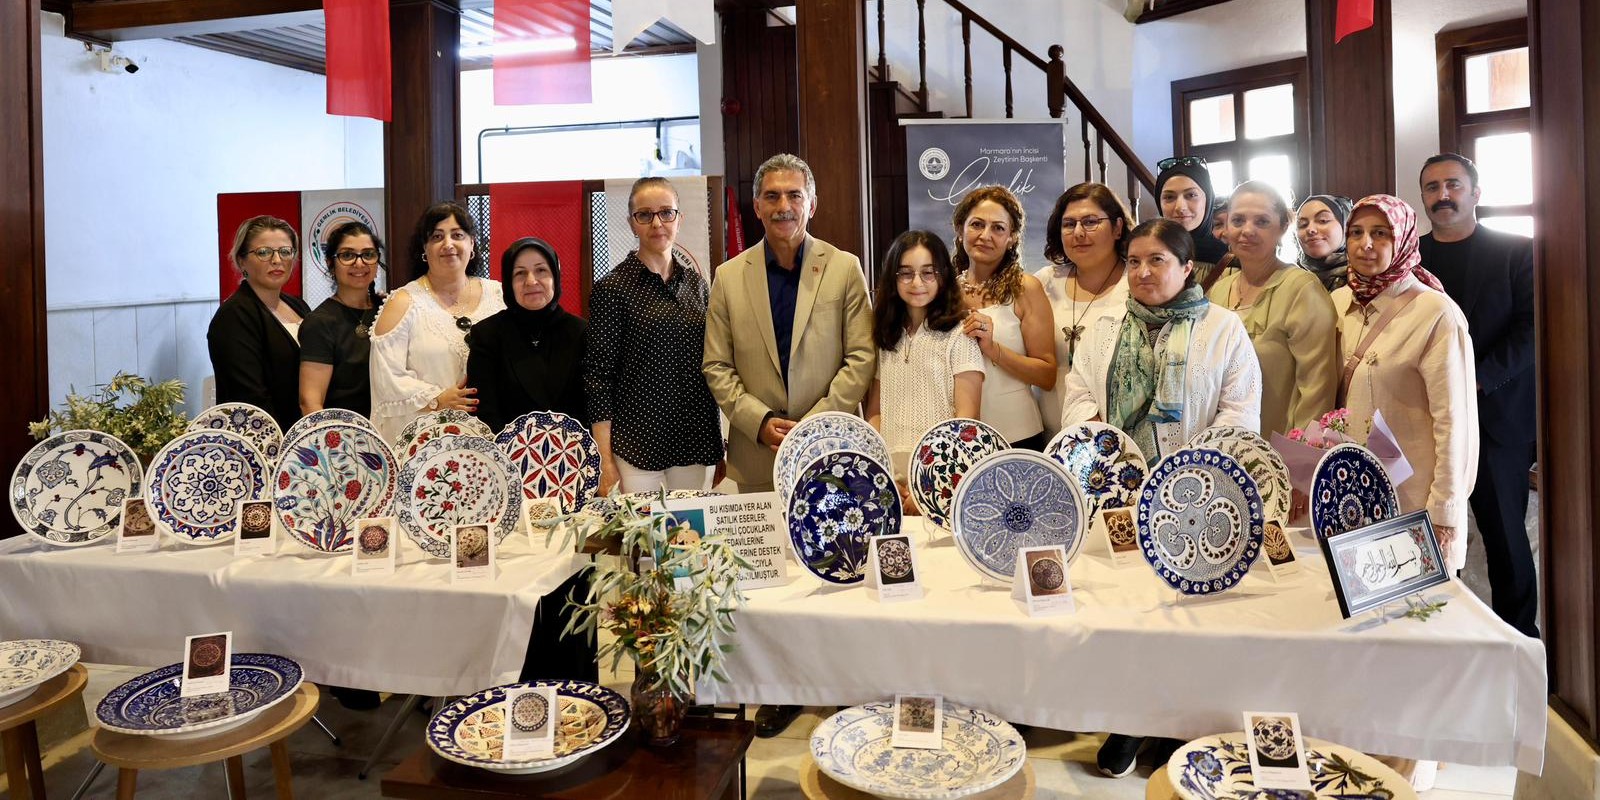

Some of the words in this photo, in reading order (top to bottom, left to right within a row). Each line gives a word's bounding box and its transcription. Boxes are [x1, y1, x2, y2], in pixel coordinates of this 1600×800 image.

[979, 147, 1022, 155] Marmara'nın
[993, 155, 1019, 164] Zeytinin
[1020, 155, 1048, 164] Başkenti
[317, 209, 337, 227] GEMLİK
[338, 207, 370, 225] BELEDİYESİ
[709, 505, 718, 514] BU
[719, 503, 743, 513] KISIMDA
[743, 502, 756, 511] YER
[756, 501, 772, 510] ALAN
[716, 515, 738, 525] SATILIK
[738, 524, 776, 535] ÇOCUKLARIN
[758, 546, 782, 556] DESTEK
